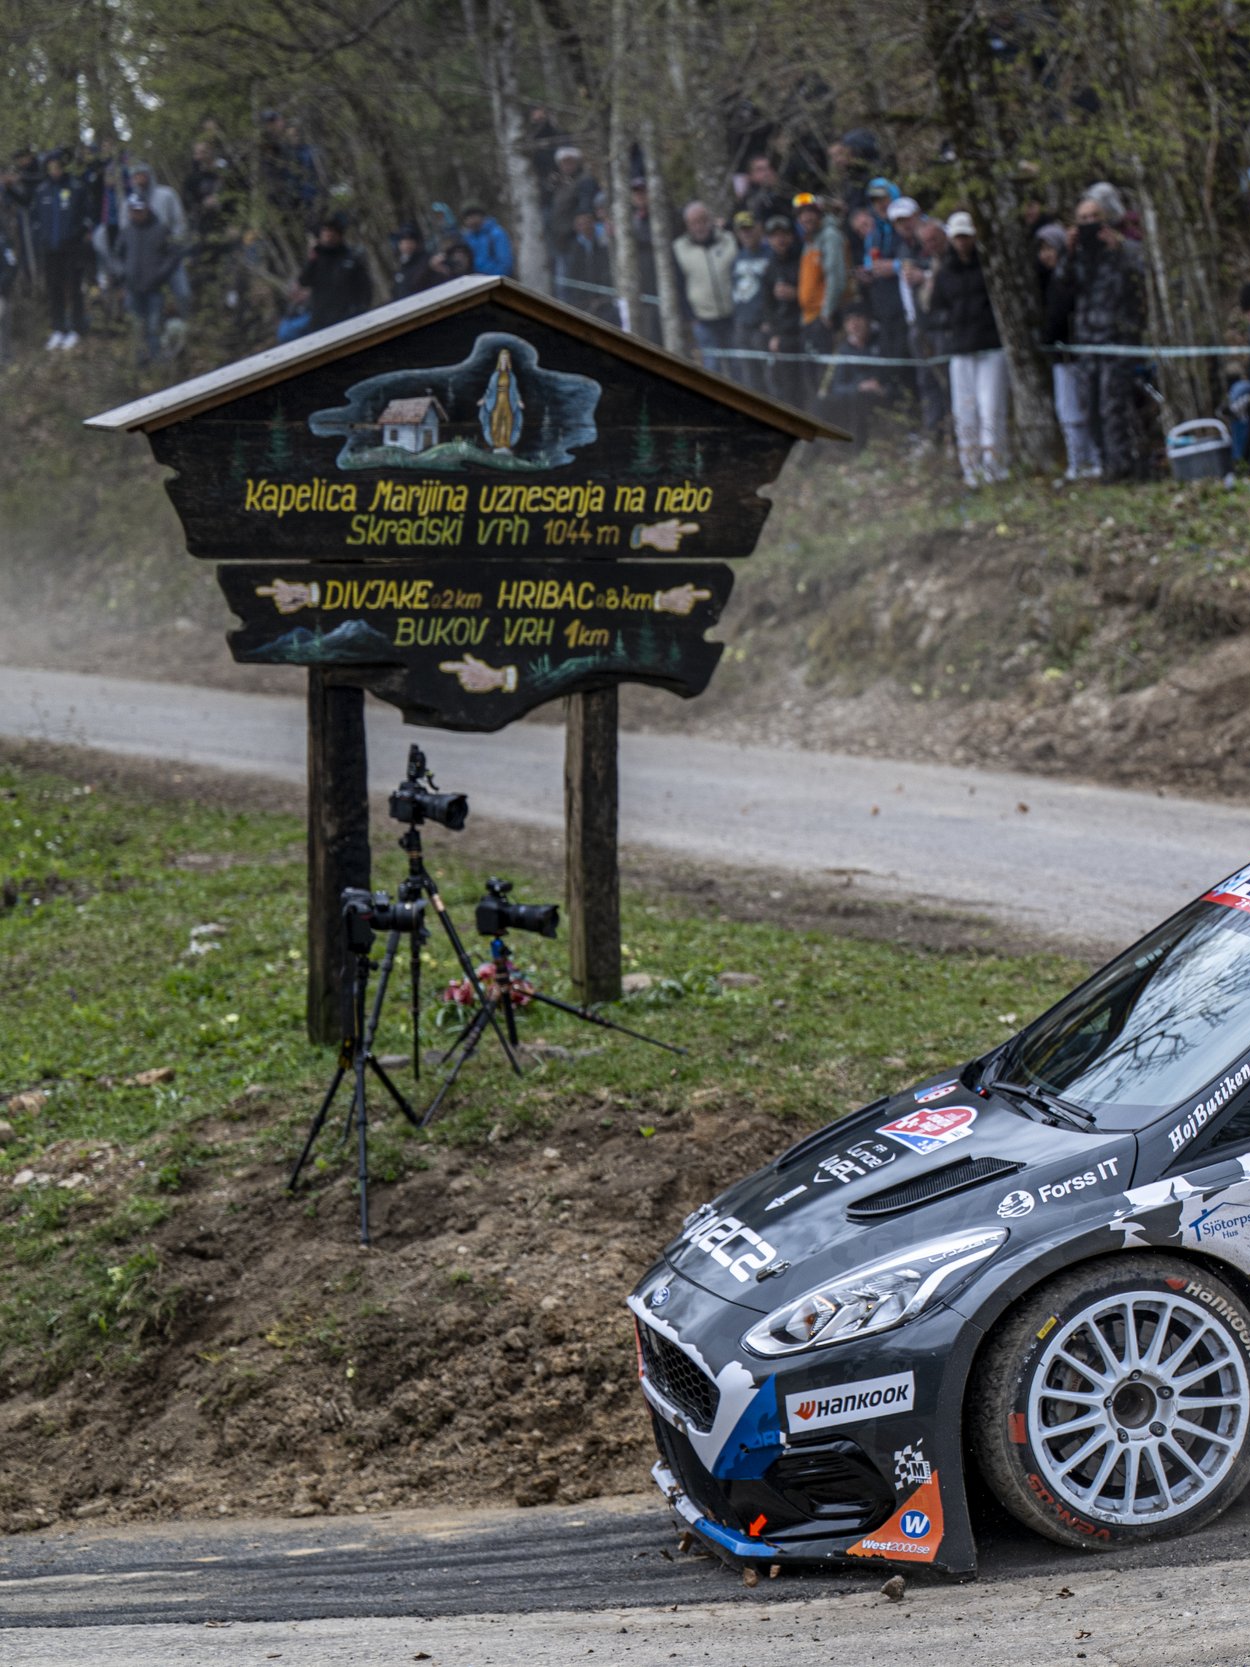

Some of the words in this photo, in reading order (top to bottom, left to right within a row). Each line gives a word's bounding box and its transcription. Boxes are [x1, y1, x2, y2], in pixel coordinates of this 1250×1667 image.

[245, 477, 357, 518] Kapelica
[368, 479, 468, 516] Marijina
[478, 480, 605, 518] uznesenja
[614, 485, 646, 513] na
[654, 480, 713, 513] nebo
[346, 513, 464, 545] Skradski
[544, 518, 593, 545] 1044
[596, 524, 620, 544] m
[322, 580, 433, 610] DIVJAKE
[497, 580, 595, 610] HRIBAC
[393, 616, 490, 646] BUKOV
[503, 617, 555, 646] VRH
[564, 619, 610, 648] 1km
[1038, 1171, 1097, 1203] Forss
[1098, 1157, 1120, 1180] IT
[1222, 1230, 1239, 1240] Hus
[1027, 1472, 1111, 1542] VENUS
[905, 1515, 929, 1534] W
[861, 1539, 930, 1554] West2000.se
